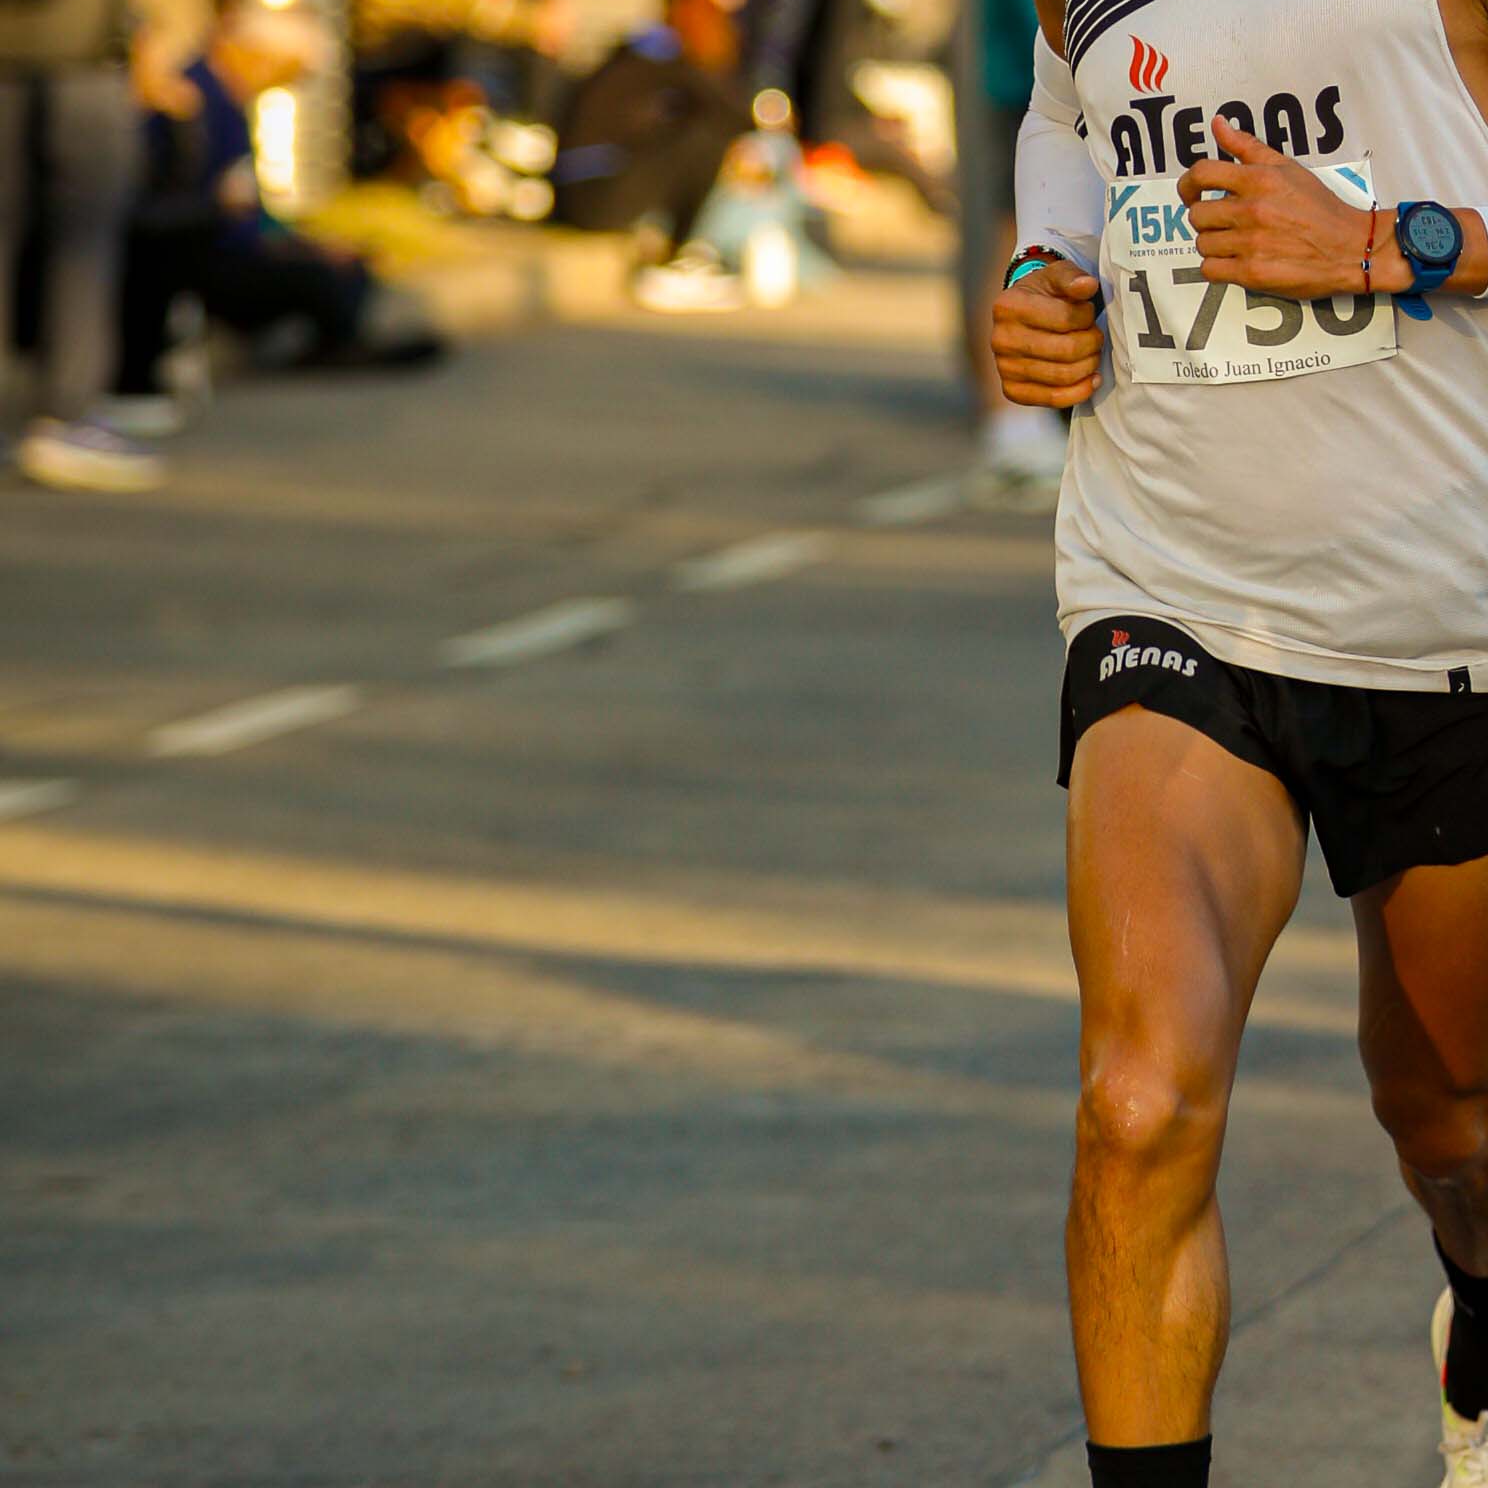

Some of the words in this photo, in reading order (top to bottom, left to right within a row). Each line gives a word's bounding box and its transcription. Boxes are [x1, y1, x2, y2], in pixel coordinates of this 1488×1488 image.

[1111, 85, 1344, 177] ATENAS
[1126, 202, 1194, 245] 15K
[1158, 247, 1185, 257] NORTE
[1187, 246, 1198, 255] 20
[1173, 361, 1218, 379] Toledo
[1224, 359, 1262, 377] Juan
[1267, 351, 1332, 377] Ignacio
[1099, 644, 1199, 683] ATENAS
